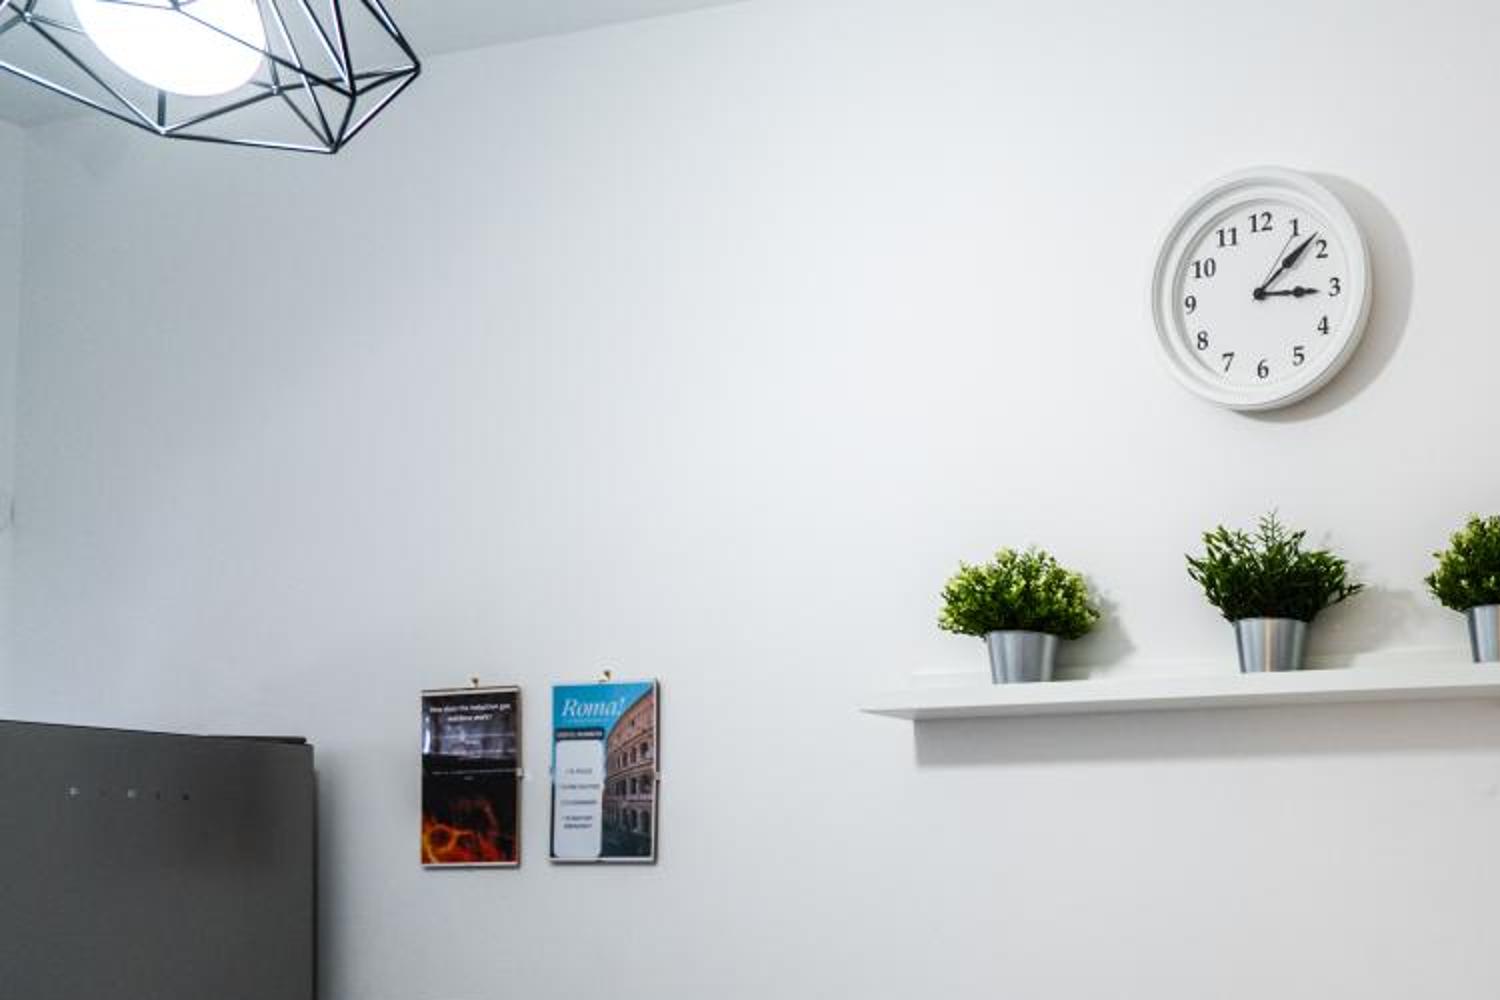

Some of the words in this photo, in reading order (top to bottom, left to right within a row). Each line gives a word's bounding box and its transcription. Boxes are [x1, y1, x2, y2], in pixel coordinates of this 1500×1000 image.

[1249, 211, 1273, 233] 12
[1290, 218, 1300, 237] 1
[1216, 227, 1239, 248] 11
[1315, 239, 1328, 259] 2
[1192, 258, 1216, 279] 10
[1328, 277, 1341, 297] 3
[1185, 295, 1197, 314] 9
[1317, 315, 1329, 335] 4
[1197, 331, 1209, 351] 8
[1222, 352, 1235, 372] 7
[1292, 345, 1305, 366] 5
[1257, 359, 1269, 379] 6
